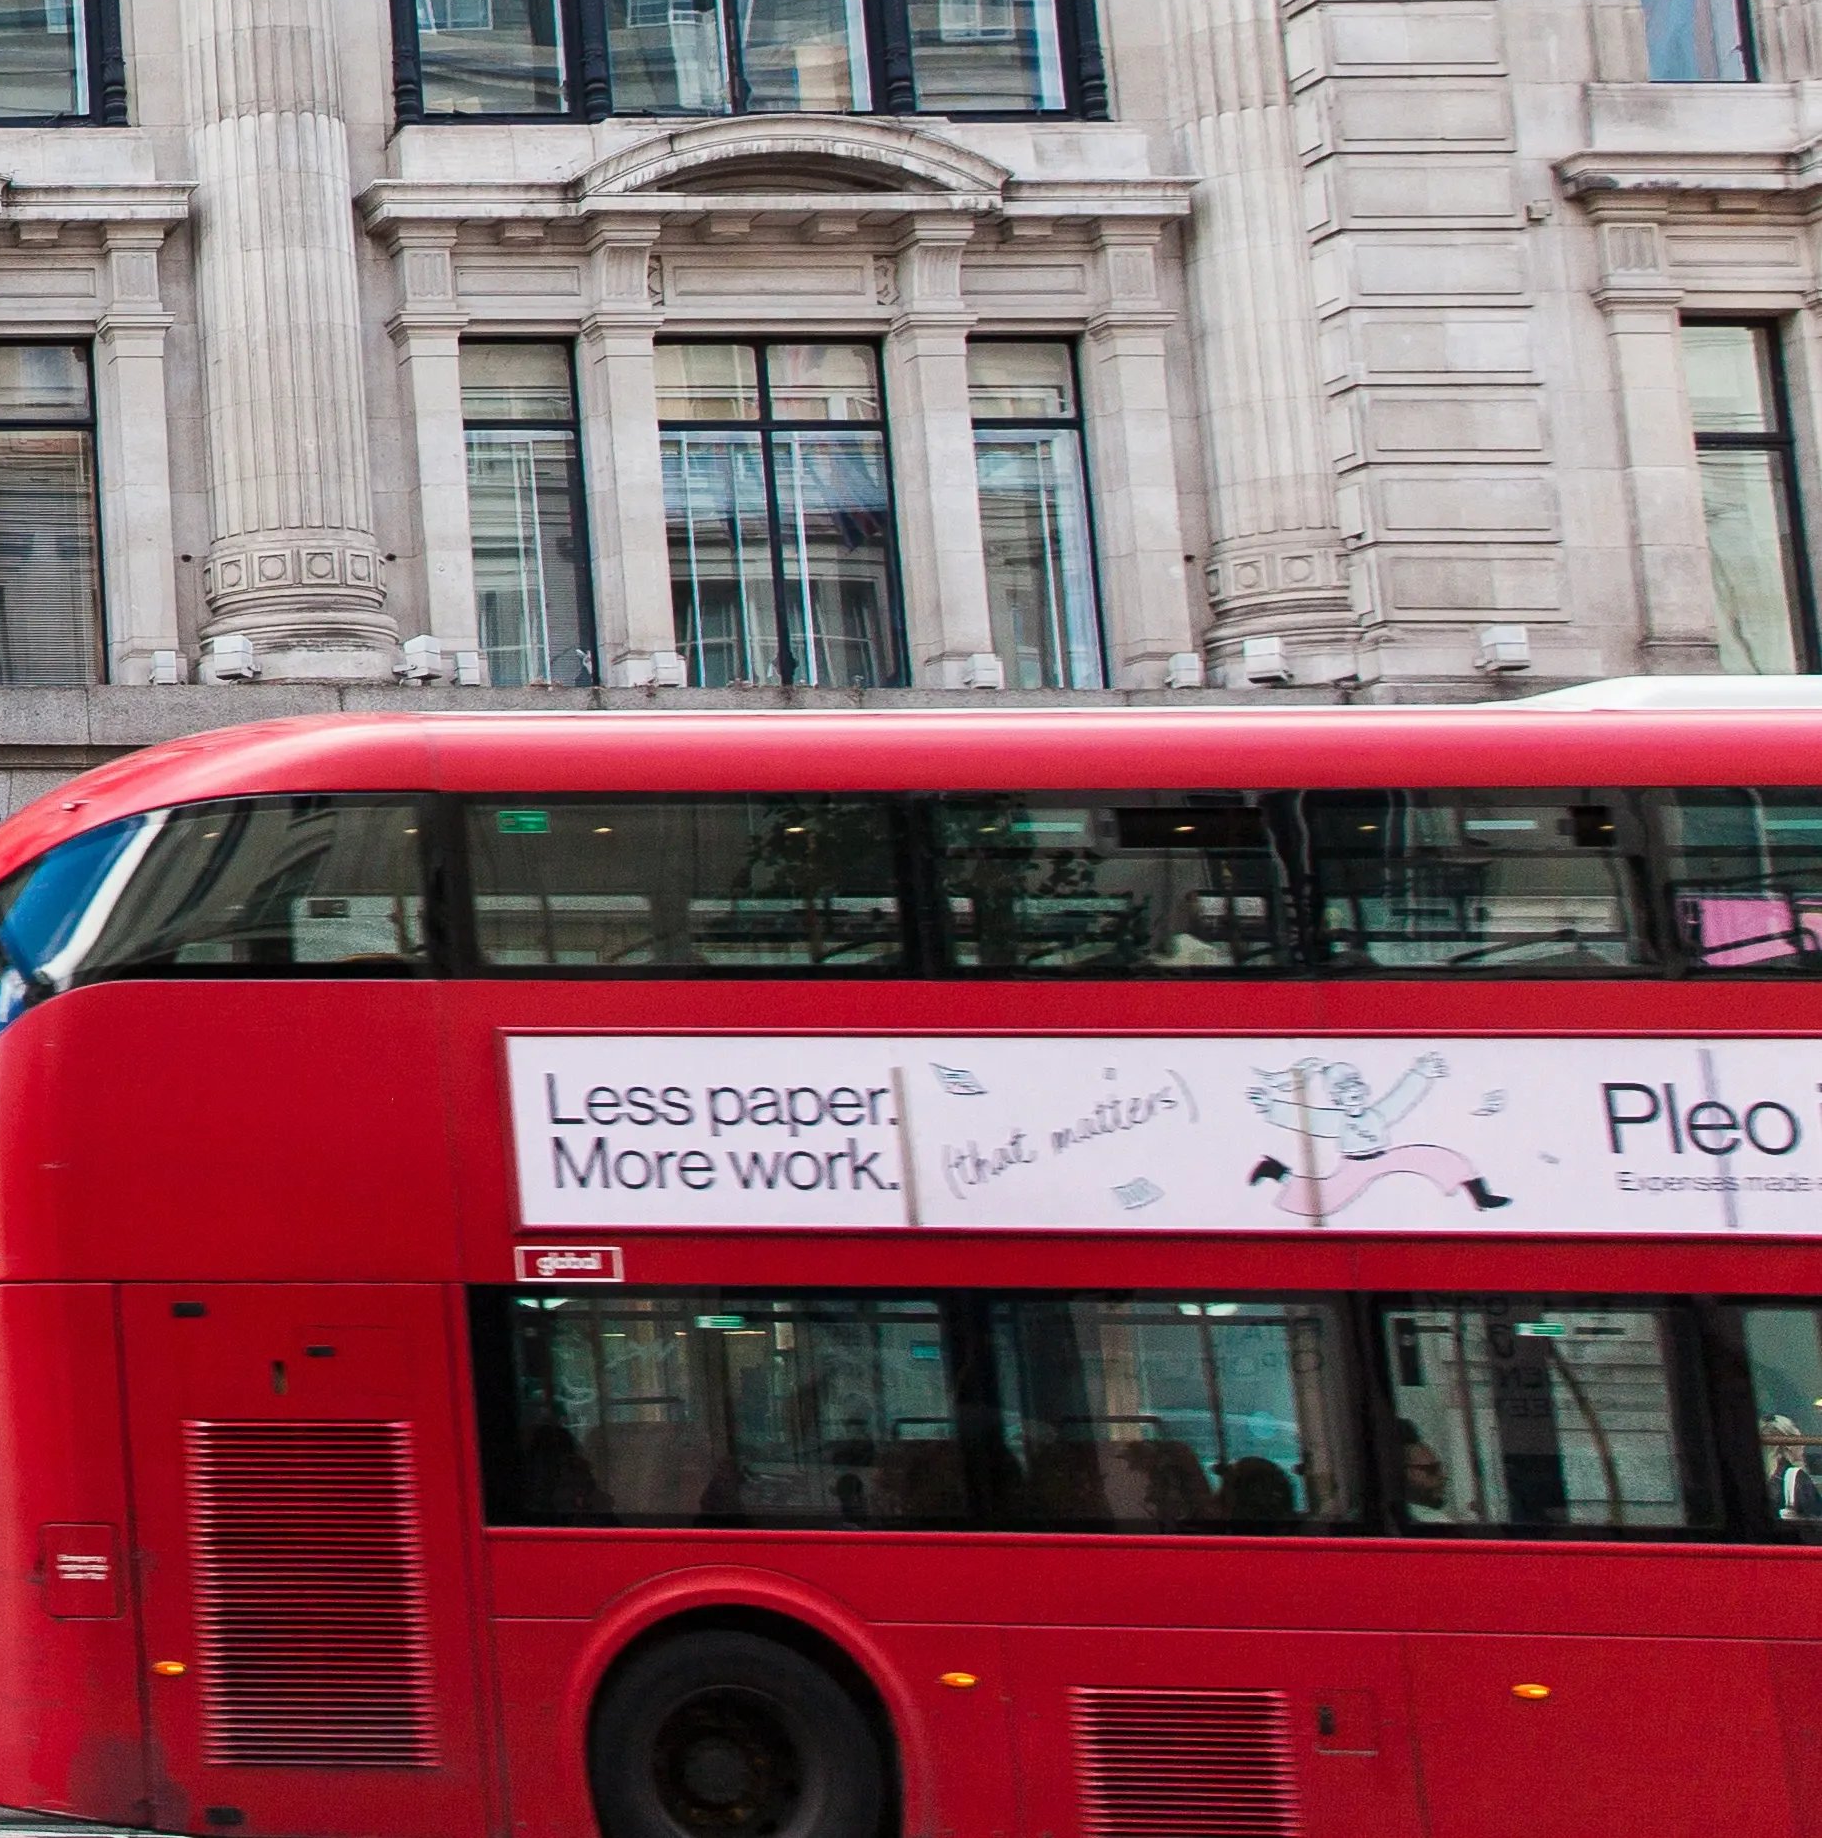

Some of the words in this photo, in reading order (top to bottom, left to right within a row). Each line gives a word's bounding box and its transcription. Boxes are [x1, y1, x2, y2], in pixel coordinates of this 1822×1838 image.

[543, 1071, 697, 1126] Less
[705, 1083, 900, 1137] paper.
[1600, 1081, 1802, 1156] Pleo
[549, 1135, 718, 1190] More
[727, 1136, 902, 1191] work.
[940, 1127, 1039, 1200] (that
